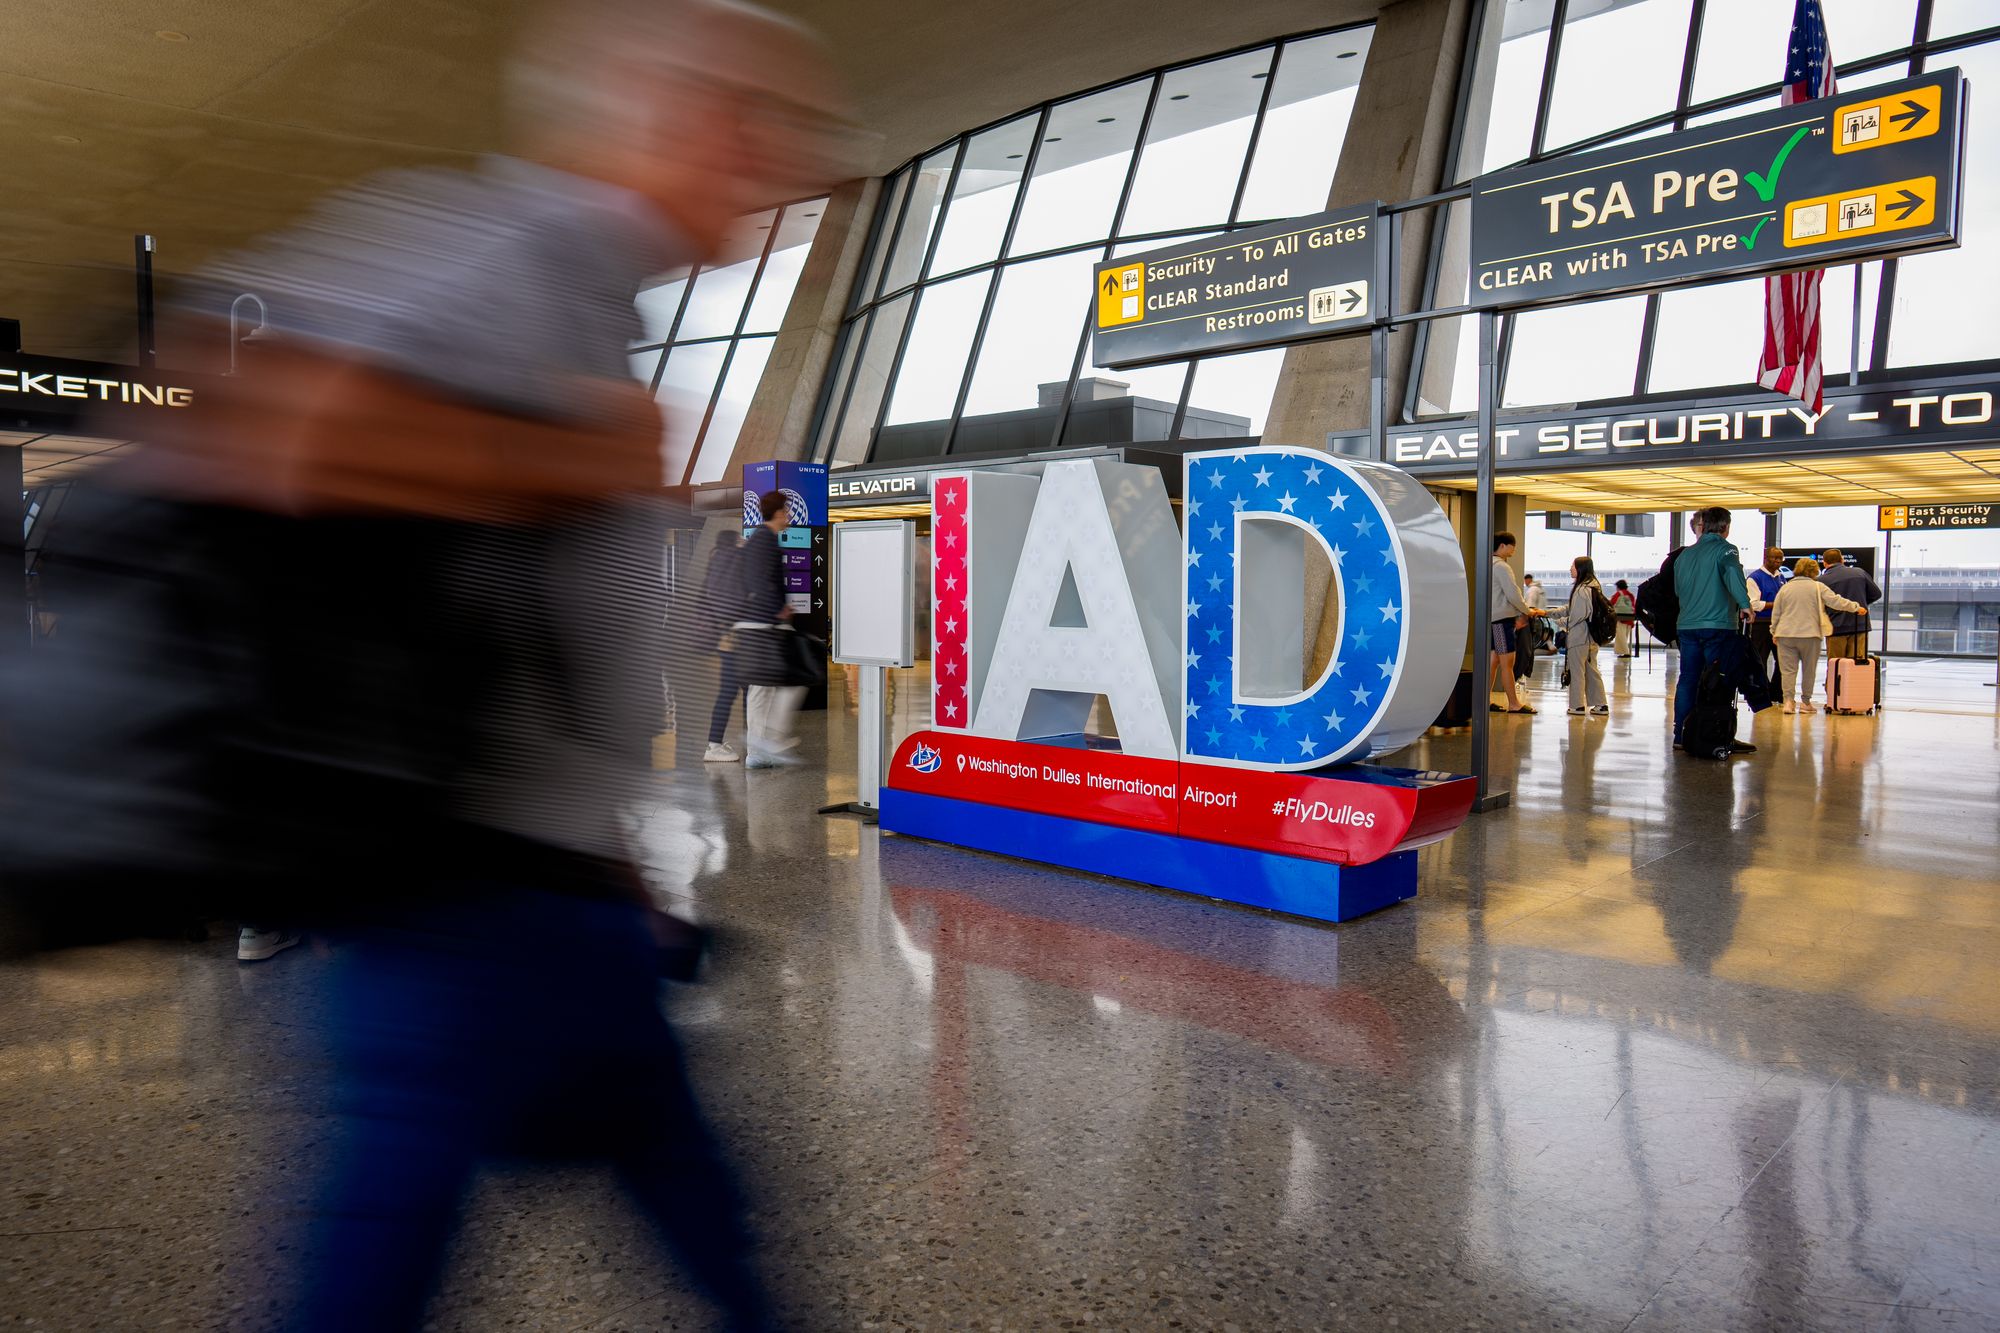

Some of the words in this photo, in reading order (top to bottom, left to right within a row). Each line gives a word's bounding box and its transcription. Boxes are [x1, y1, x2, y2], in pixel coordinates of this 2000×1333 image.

[1541, 180, 1635, 233] TSA
[1653, 168, 1739, 214] Pre
[1147, 255, 1216, 283] Security
[1243, 246, 1264, 263] To
[1273, 235, 1298, 257] All
[1308, 224, 1366, 249] Gates
[1479, 262, 1553, 290] CLEAR
[1567, 248, 1627, 276] with
[1641, 238, 1688, 264] TSA
[1696, 232, 1737, 255] Pre
[1147, 288, 1197, 311] CLEAR
[1205, 270, 1288, 300] Standard
[1206, 304, 1304, 333] Restrooms
[1395, 429, 1520, 462] EAST
[1538, 404, 1834, 453] SECURITY
[1849, 411, 1878, 421] -
[1893, 391, 1991, 428] TO
[829, 477, 916, 497] ELEVATOR
[1909, 507, 1934, 516] East
[1940, 505, 1991, 515] Security
[1909, 518, 1923, 526] To
[1929, 516, 1945, 526] All
[1950, 516, 1987, 525] Gates
[930, 445, 1411, 773] IAD
[968, 755, 1038, 779] Washington
[1043, 766, 1081, 785] Dulles
[1087, 772, 1176, 799] International
[1184, 786, 1237, 808] Airport
[1272, 797, 1376, 828] #FlyDulles
